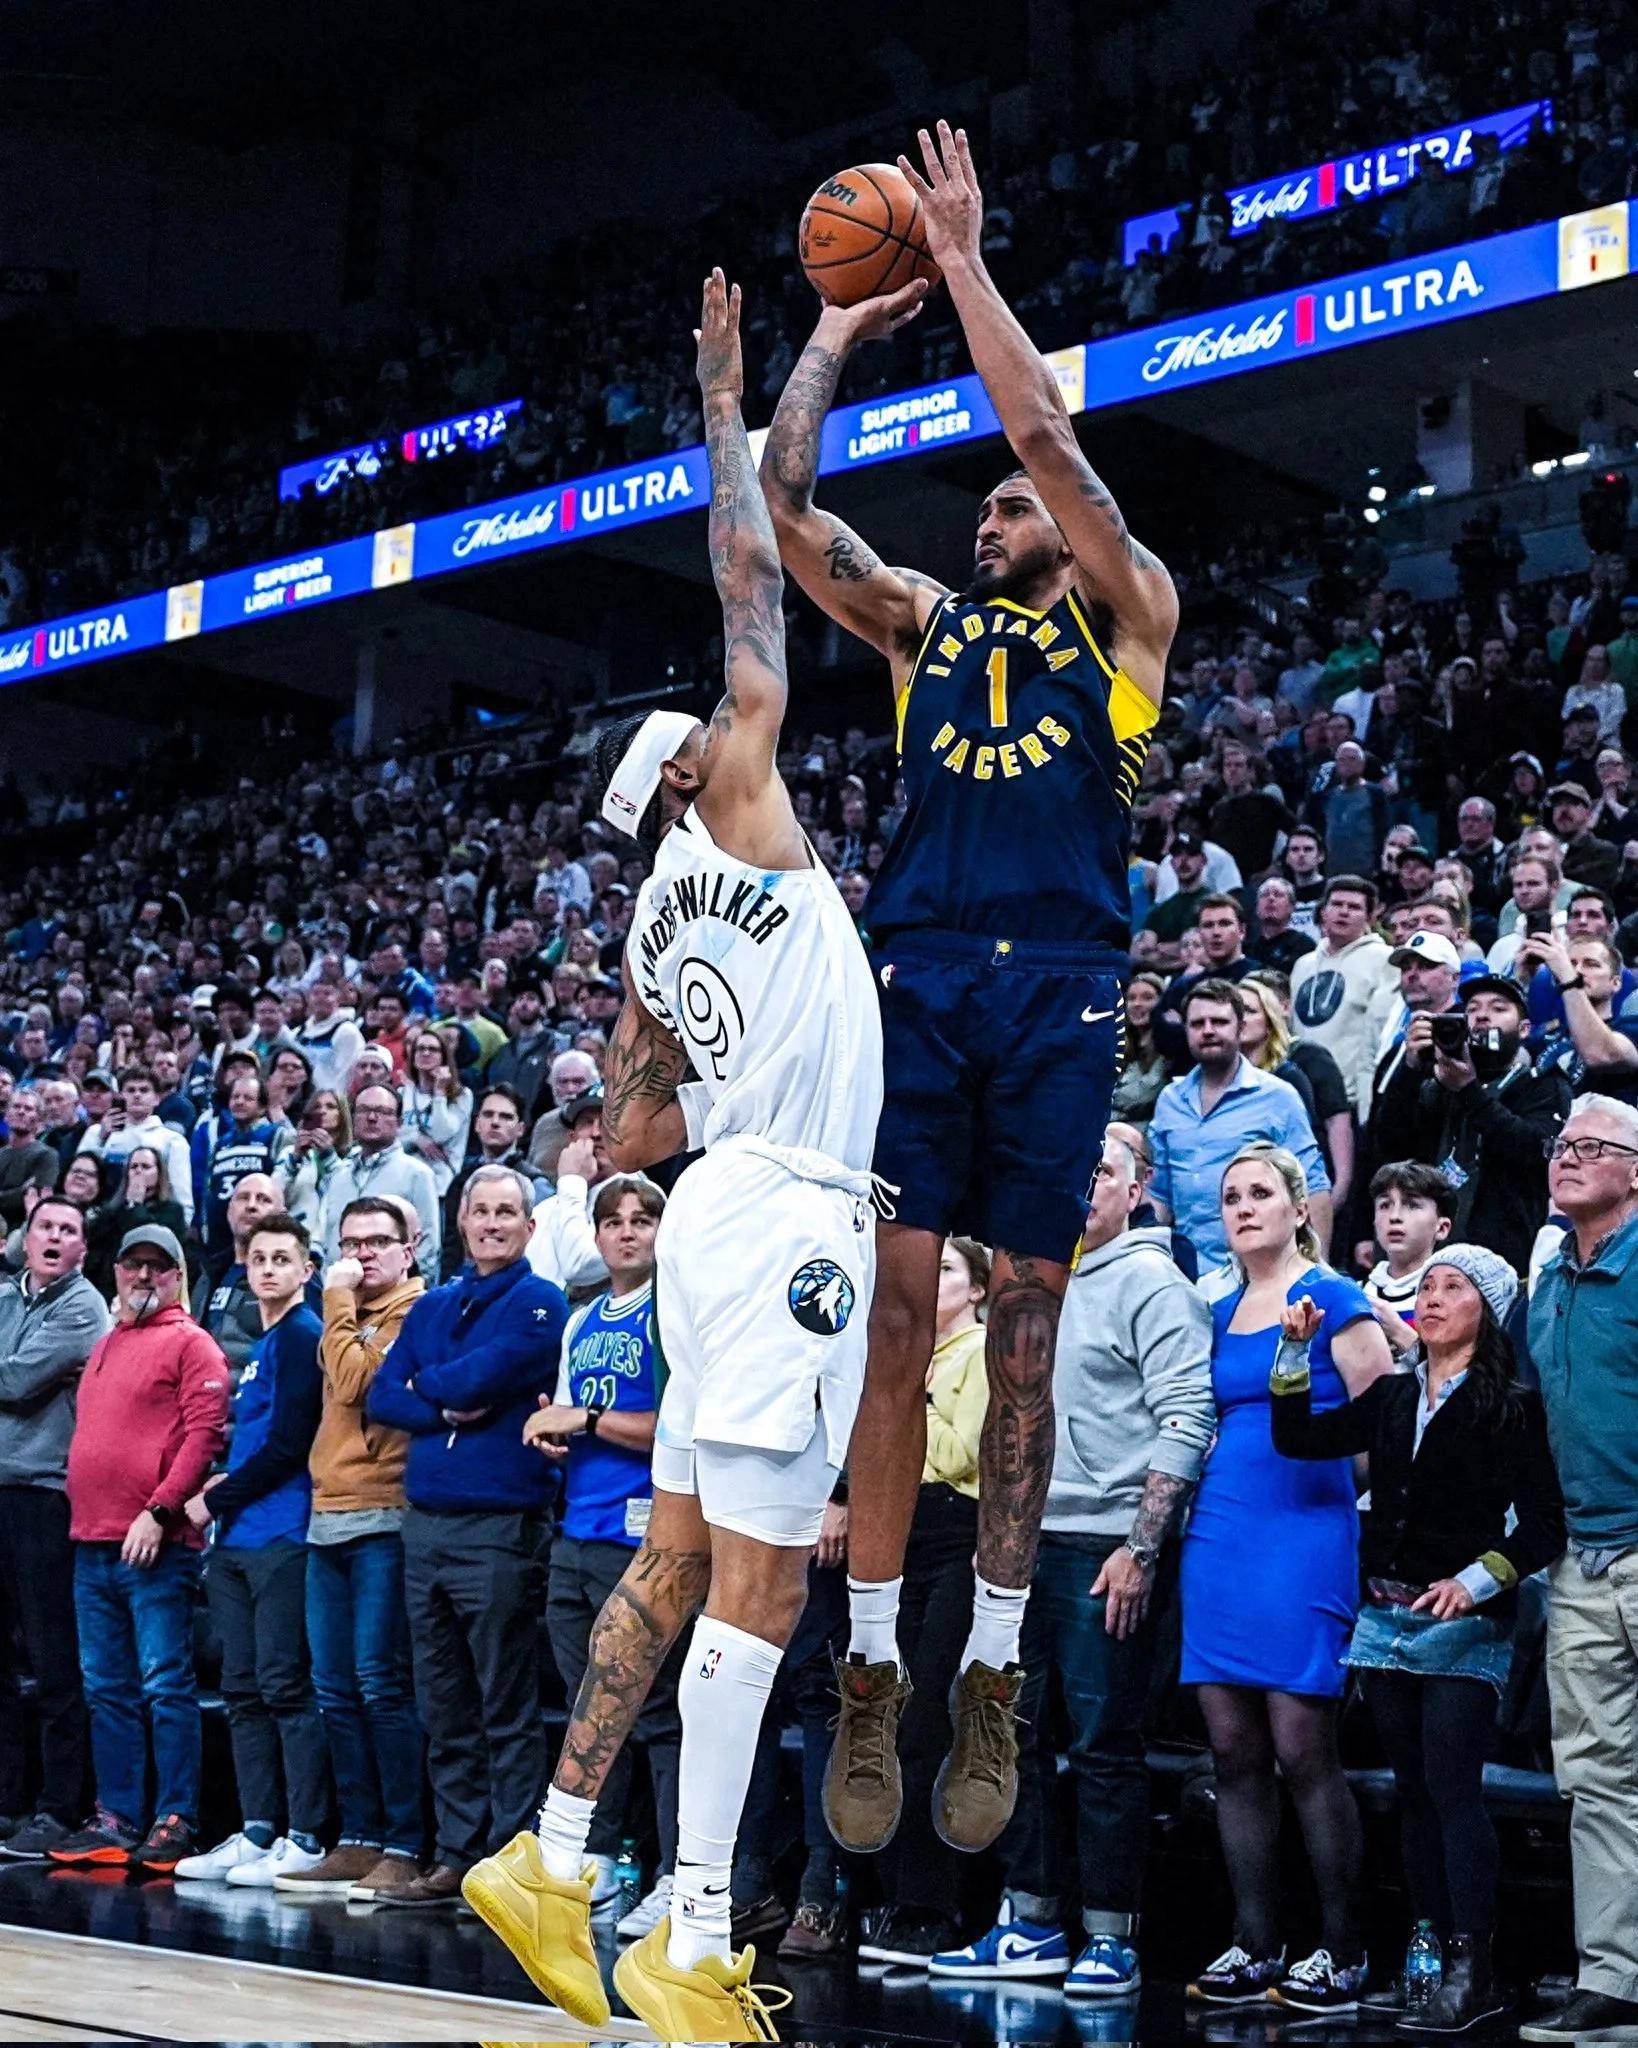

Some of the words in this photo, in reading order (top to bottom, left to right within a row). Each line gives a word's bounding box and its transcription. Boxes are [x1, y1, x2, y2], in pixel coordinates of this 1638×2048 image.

[1142, 308, 1288, 382] Michelob
[1325, 260, 1481, 333] ULTRA
[849, 426, 906, 459] LIGHT
[920, 410, 970, 441] BEER
[861, 389, 957, 432] SUPERIOR
[581, 465, 692, 522] ULTRA
[244, 587, 286, 613] LIGHT
[295, 574, 333, 600] BEER
[48, 613, 128, 660] ULTRA
[926, 612, 1079, 677] INDIANA
[986, 647, 1007, 728] 1
[931, 716, 1071, 780] PACERS
[678, 956, 745, 1081] 9
